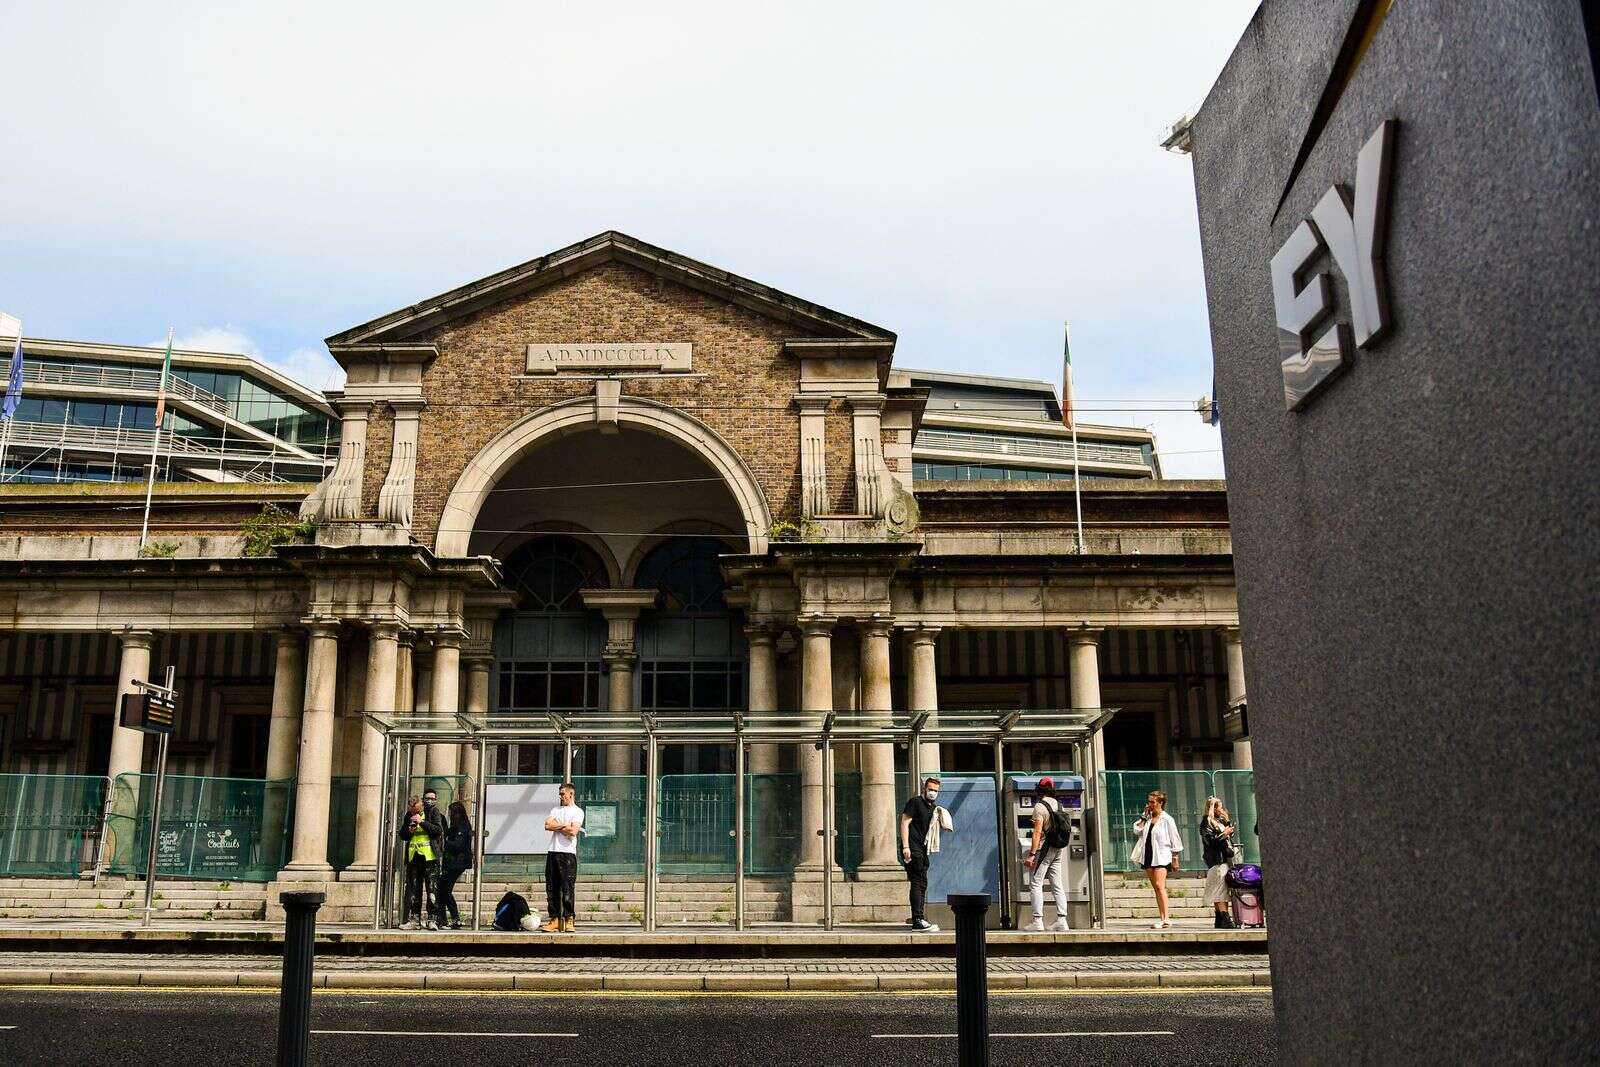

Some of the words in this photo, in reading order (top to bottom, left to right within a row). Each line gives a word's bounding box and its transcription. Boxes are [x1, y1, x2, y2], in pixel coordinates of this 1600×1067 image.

[1270, 119, 1396, 412] EY
[540, 349, 572, 361] A.D.
[577, 349, 677, 361] MDCCCLIX
